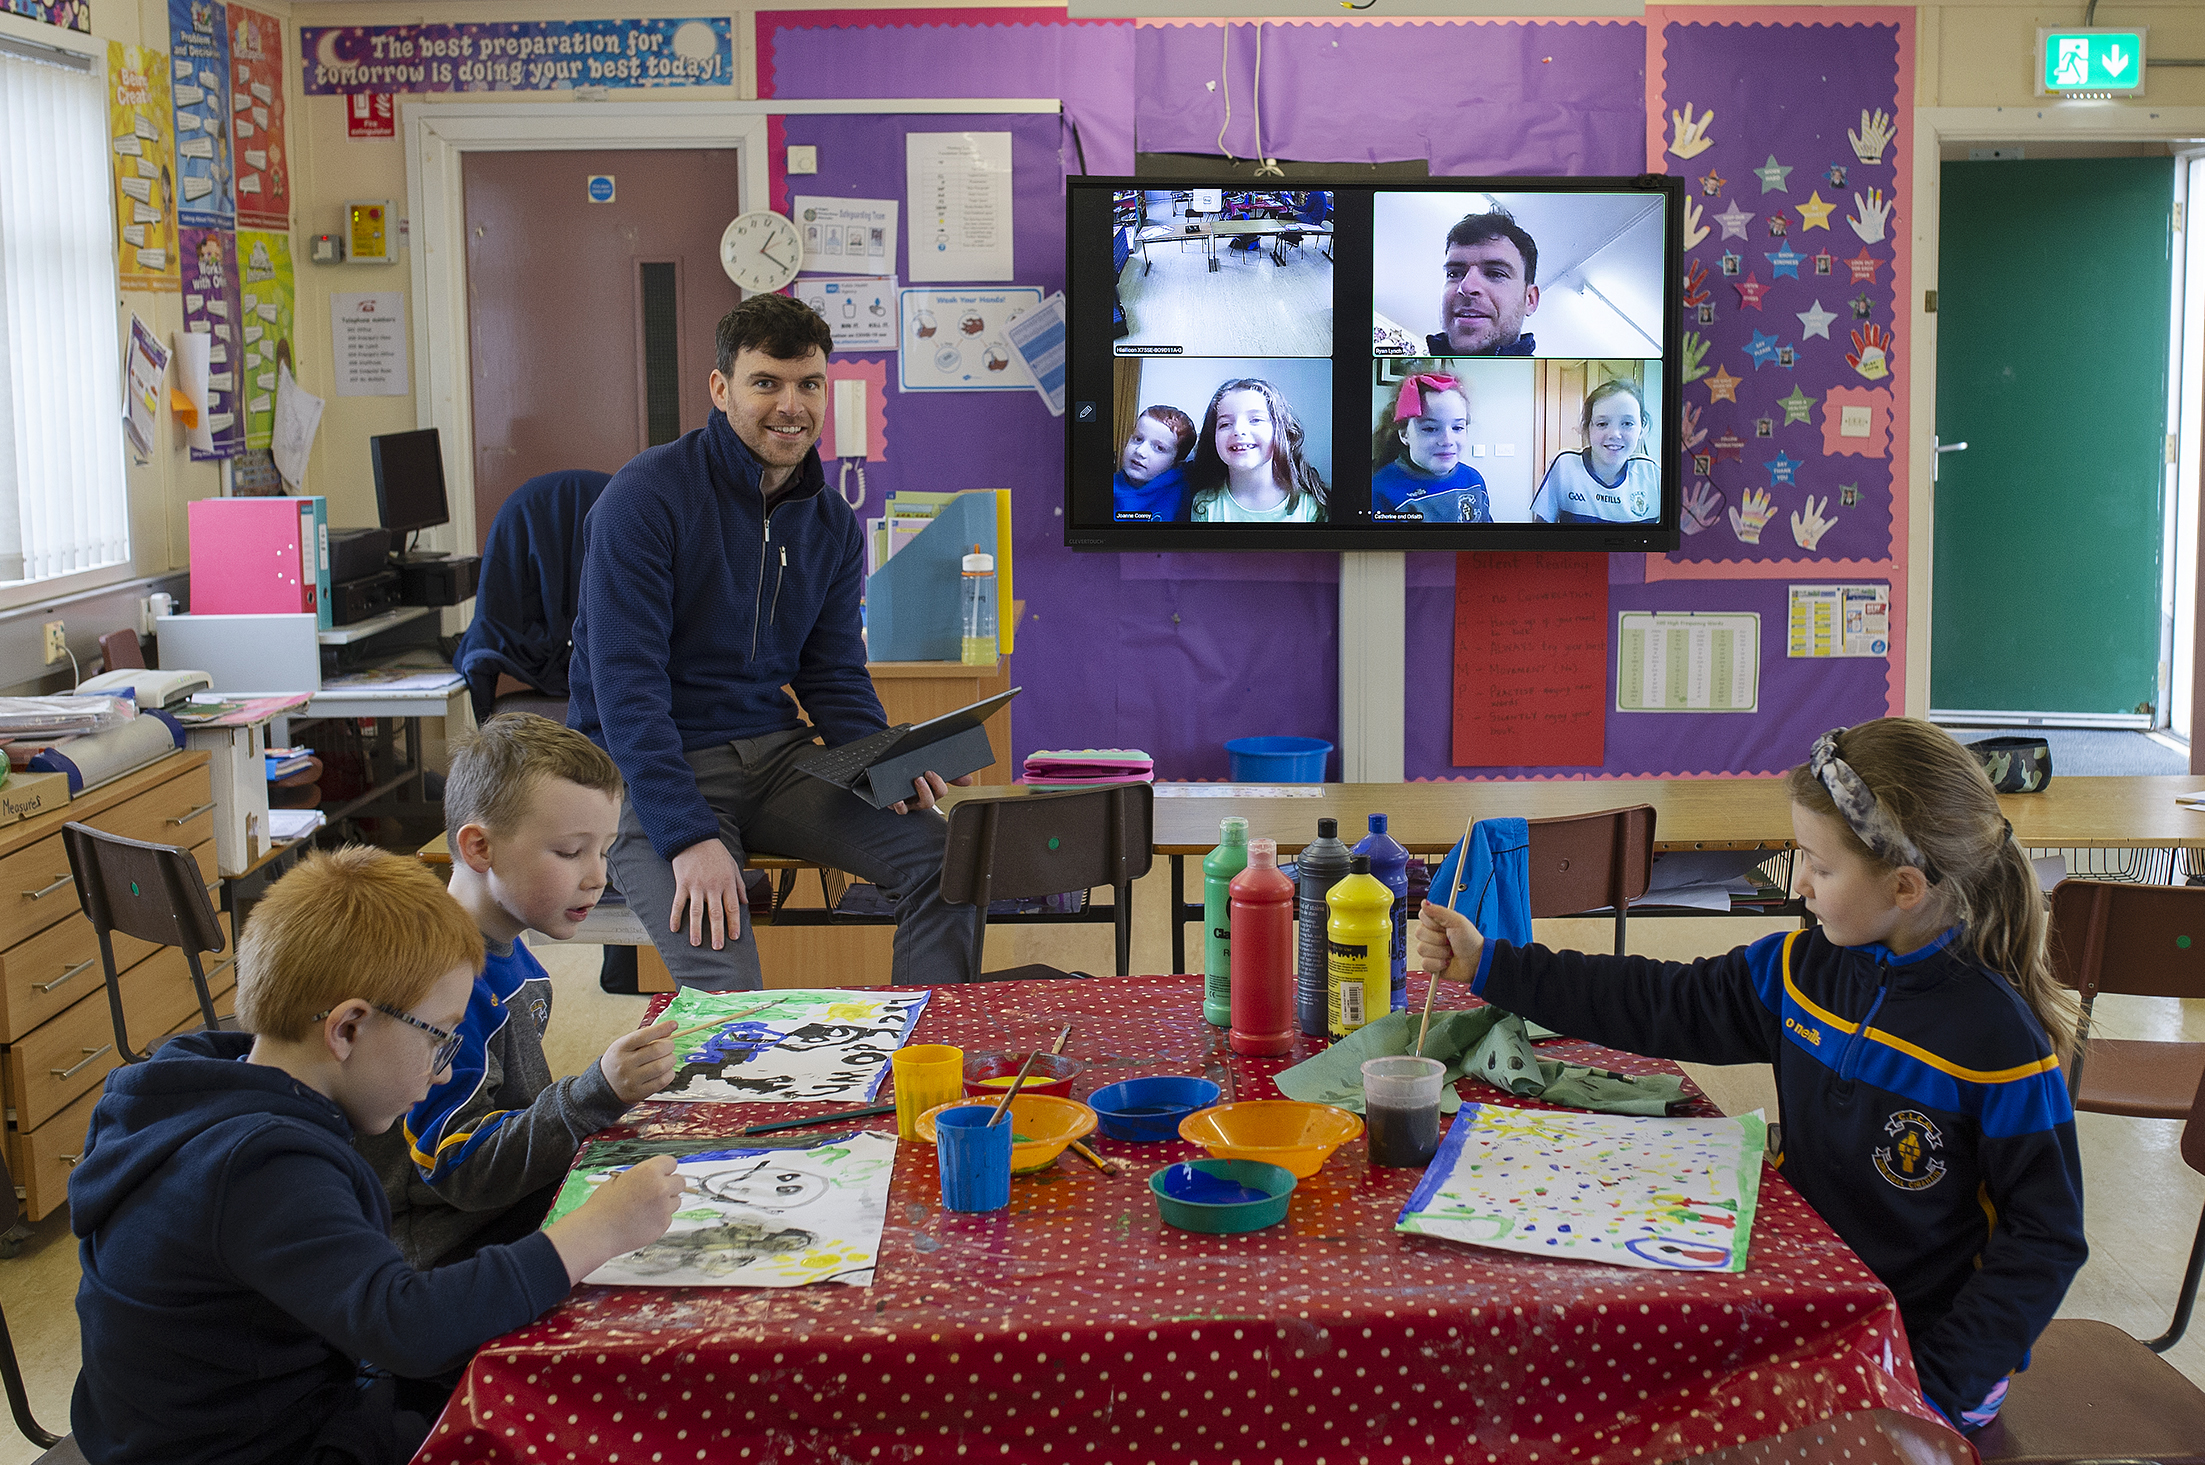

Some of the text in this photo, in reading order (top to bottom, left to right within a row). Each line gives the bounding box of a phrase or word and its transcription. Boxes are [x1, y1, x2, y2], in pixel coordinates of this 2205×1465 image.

[371, 29, 663, 63] The best preparation for
[315, 53, 722, 86] tomorrow is doing your best today!
[364, 119, 379, 128] Fire
[750, 220, 758, 228] 11
[764, 219, 772, 228] 12
[1754, 346, 1771, 356] PLEASE
[1568, 492, 1586, 502] GAA
[1472, 552, 1589, 577] Silent Reading
[1458, 588, 1470, 604] C
[1492, 594, 1506, 604] no
[2, 794, 42, 816] Measures
